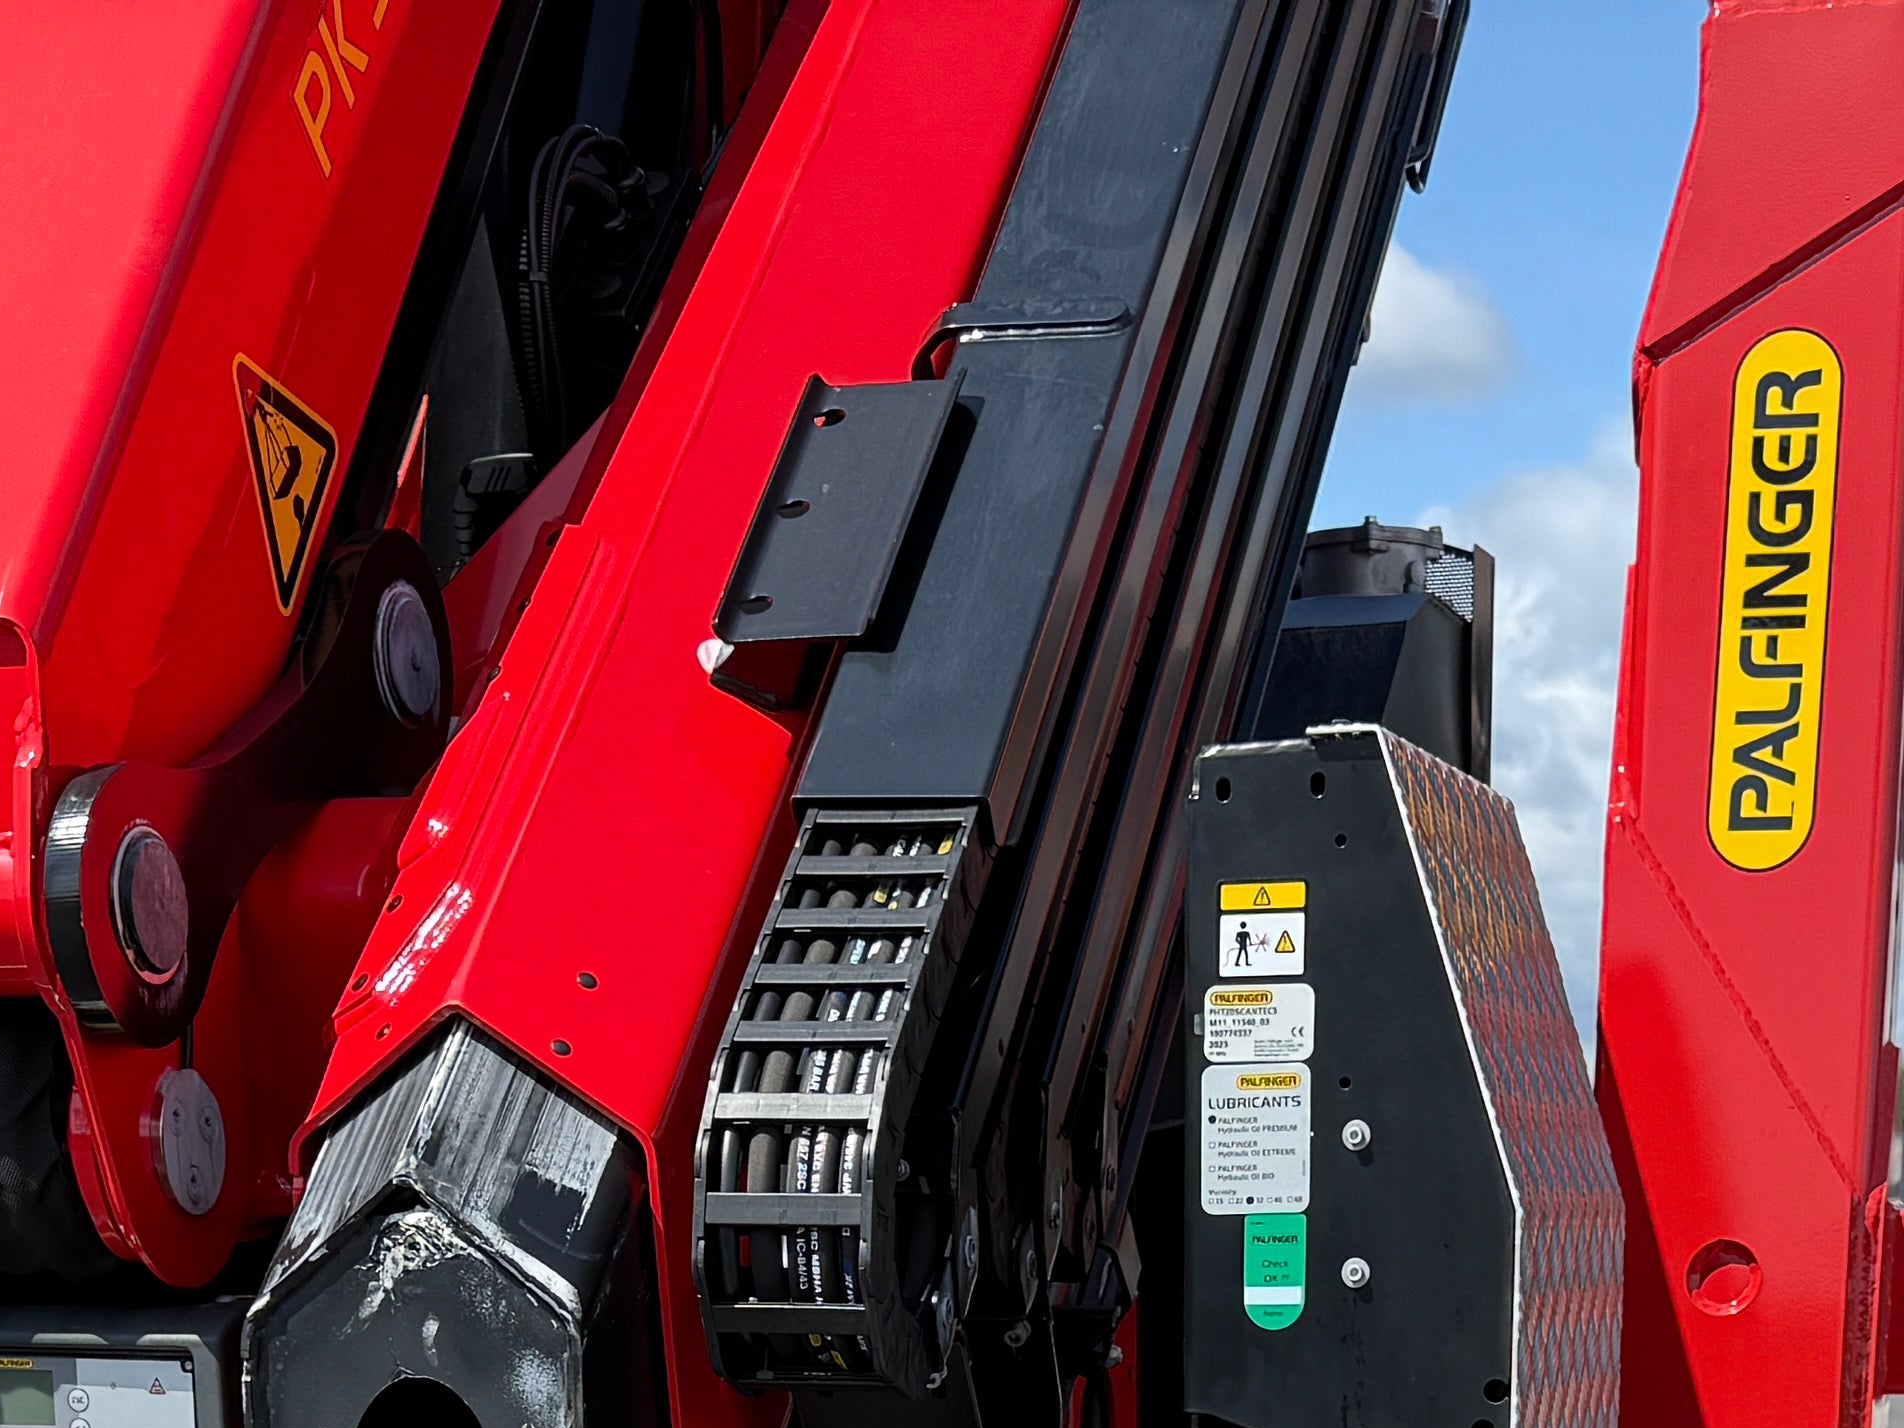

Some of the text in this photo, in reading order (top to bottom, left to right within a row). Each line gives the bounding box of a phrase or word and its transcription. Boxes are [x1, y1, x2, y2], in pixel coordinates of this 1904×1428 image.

[1726, 367, 1823, 832] PALFINGER
[1214, 993, 1268, 1003] PALFINGER
[1240, 1075, 1297, 1087] PALFINGER
[1208, 1095, 1302, 1110] LUBRICANTS
